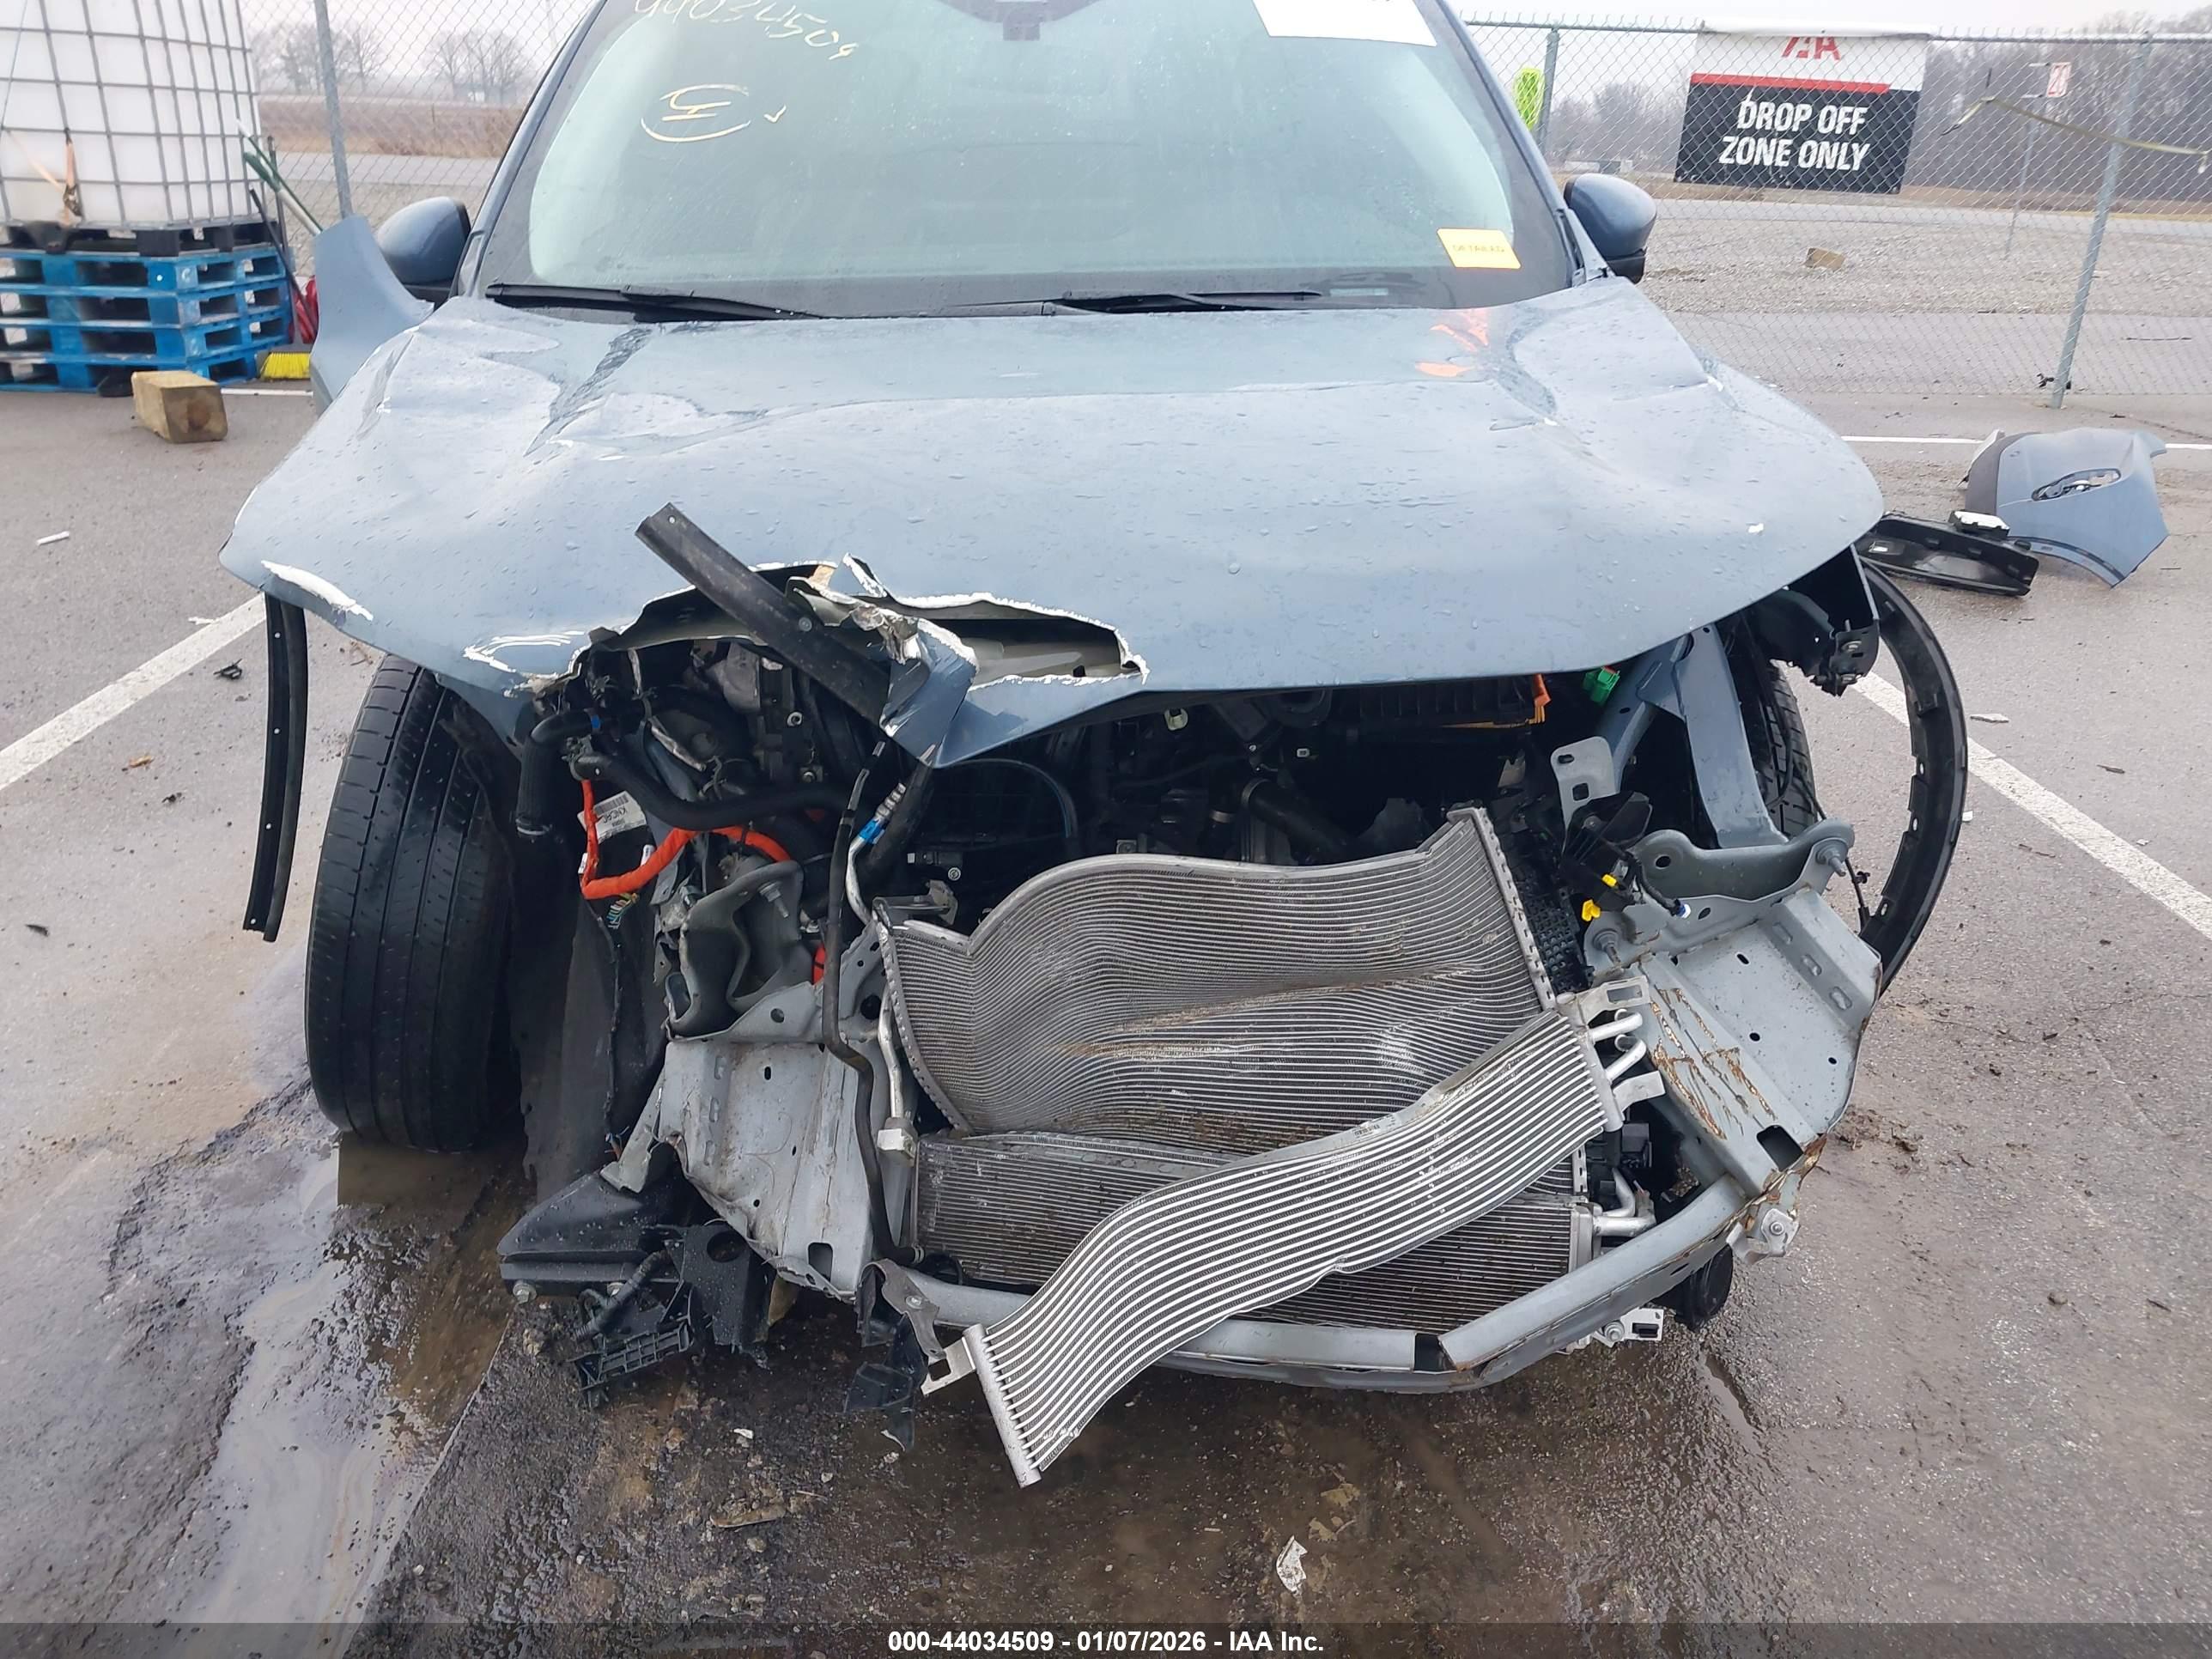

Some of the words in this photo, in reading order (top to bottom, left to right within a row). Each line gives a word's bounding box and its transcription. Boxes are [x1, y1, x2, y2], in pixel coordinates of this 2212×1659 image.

[1737, 100, 1813, 131] DROP
[1818, 105, 1869, 135] OFF
[1718, 136, 1794, 167] ZONE
[1798, 140, 1871, 171] ONLY
